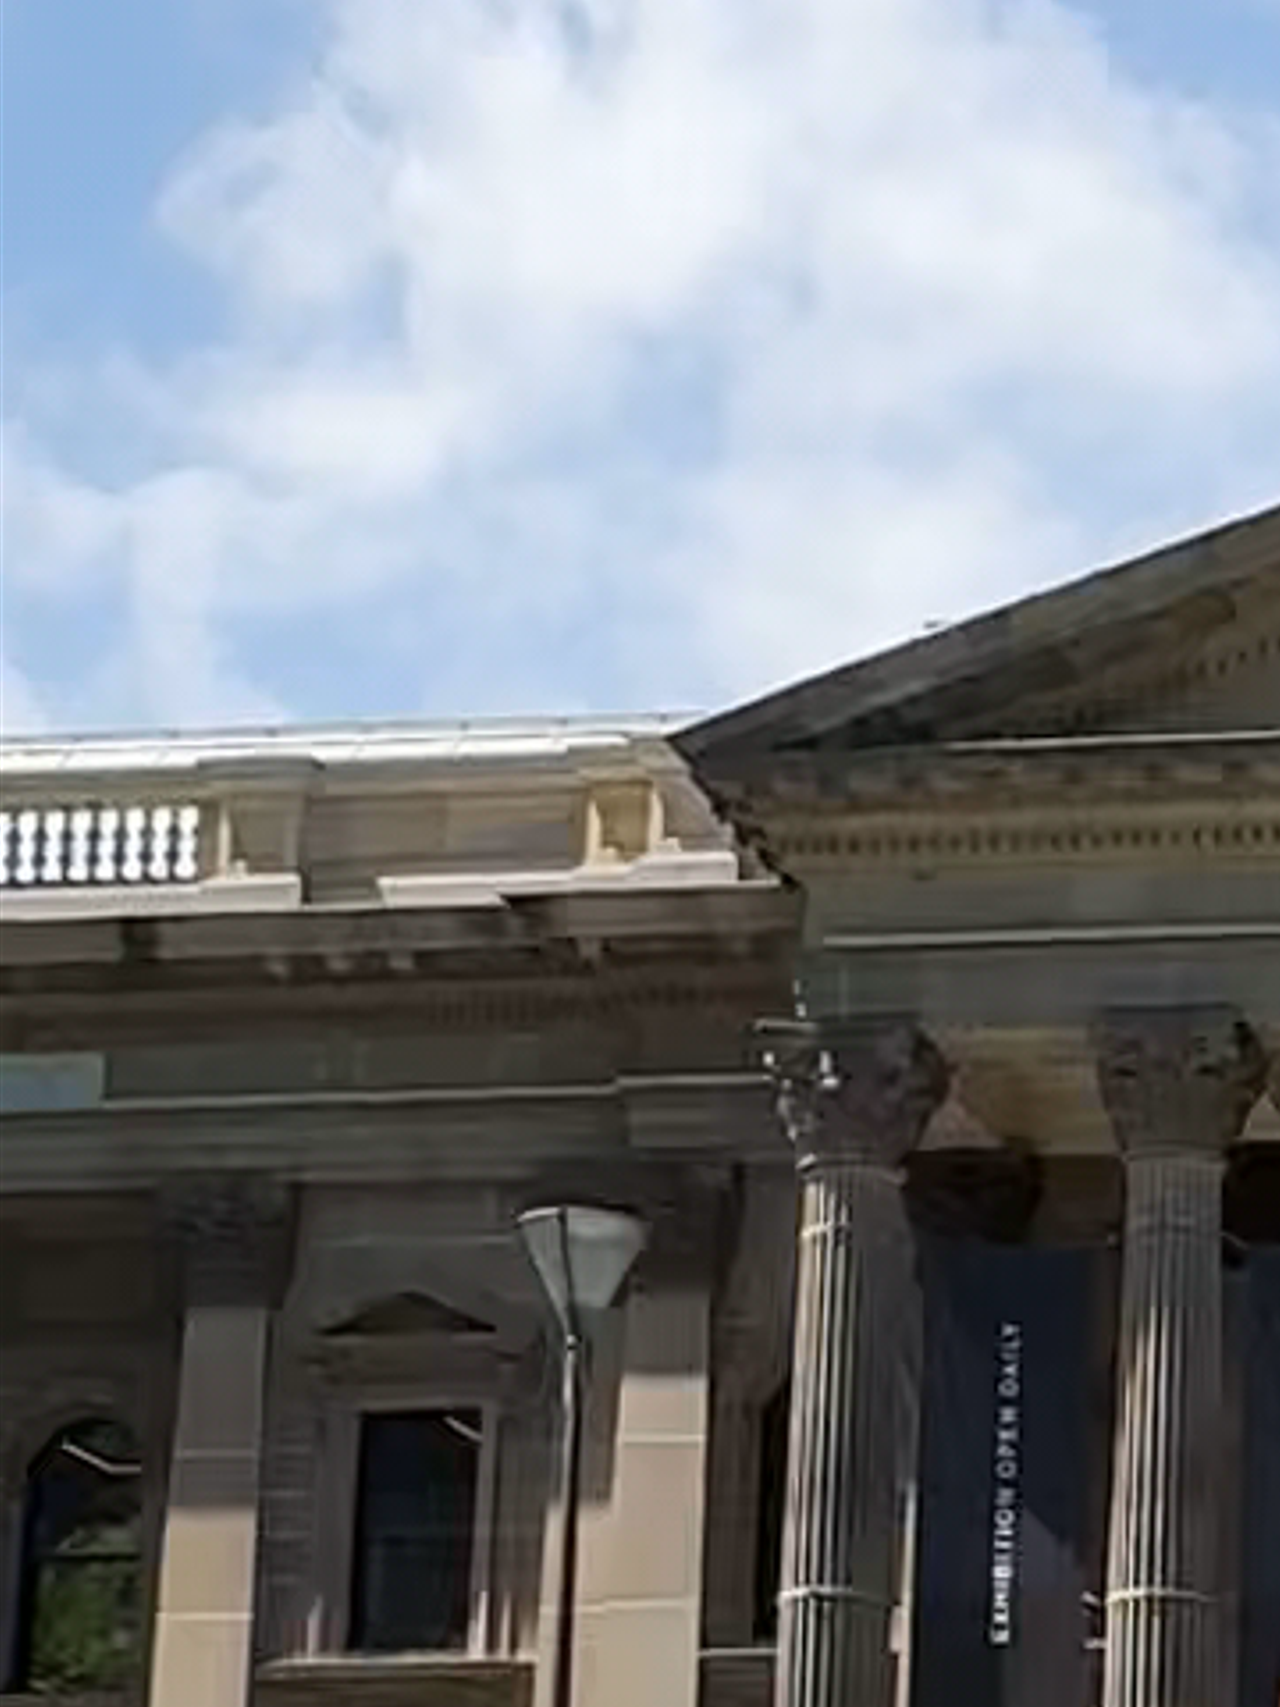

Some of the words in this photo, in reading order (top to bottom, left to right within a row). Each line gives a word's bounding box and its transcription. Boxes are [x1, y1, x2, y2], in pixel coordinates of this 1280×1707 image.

[998, 1322, 1022, 1398] DAILY
[996, 1406, 1019, 1479] OPEN
[992, 1488, 1017, 1643] EXHIBITION
